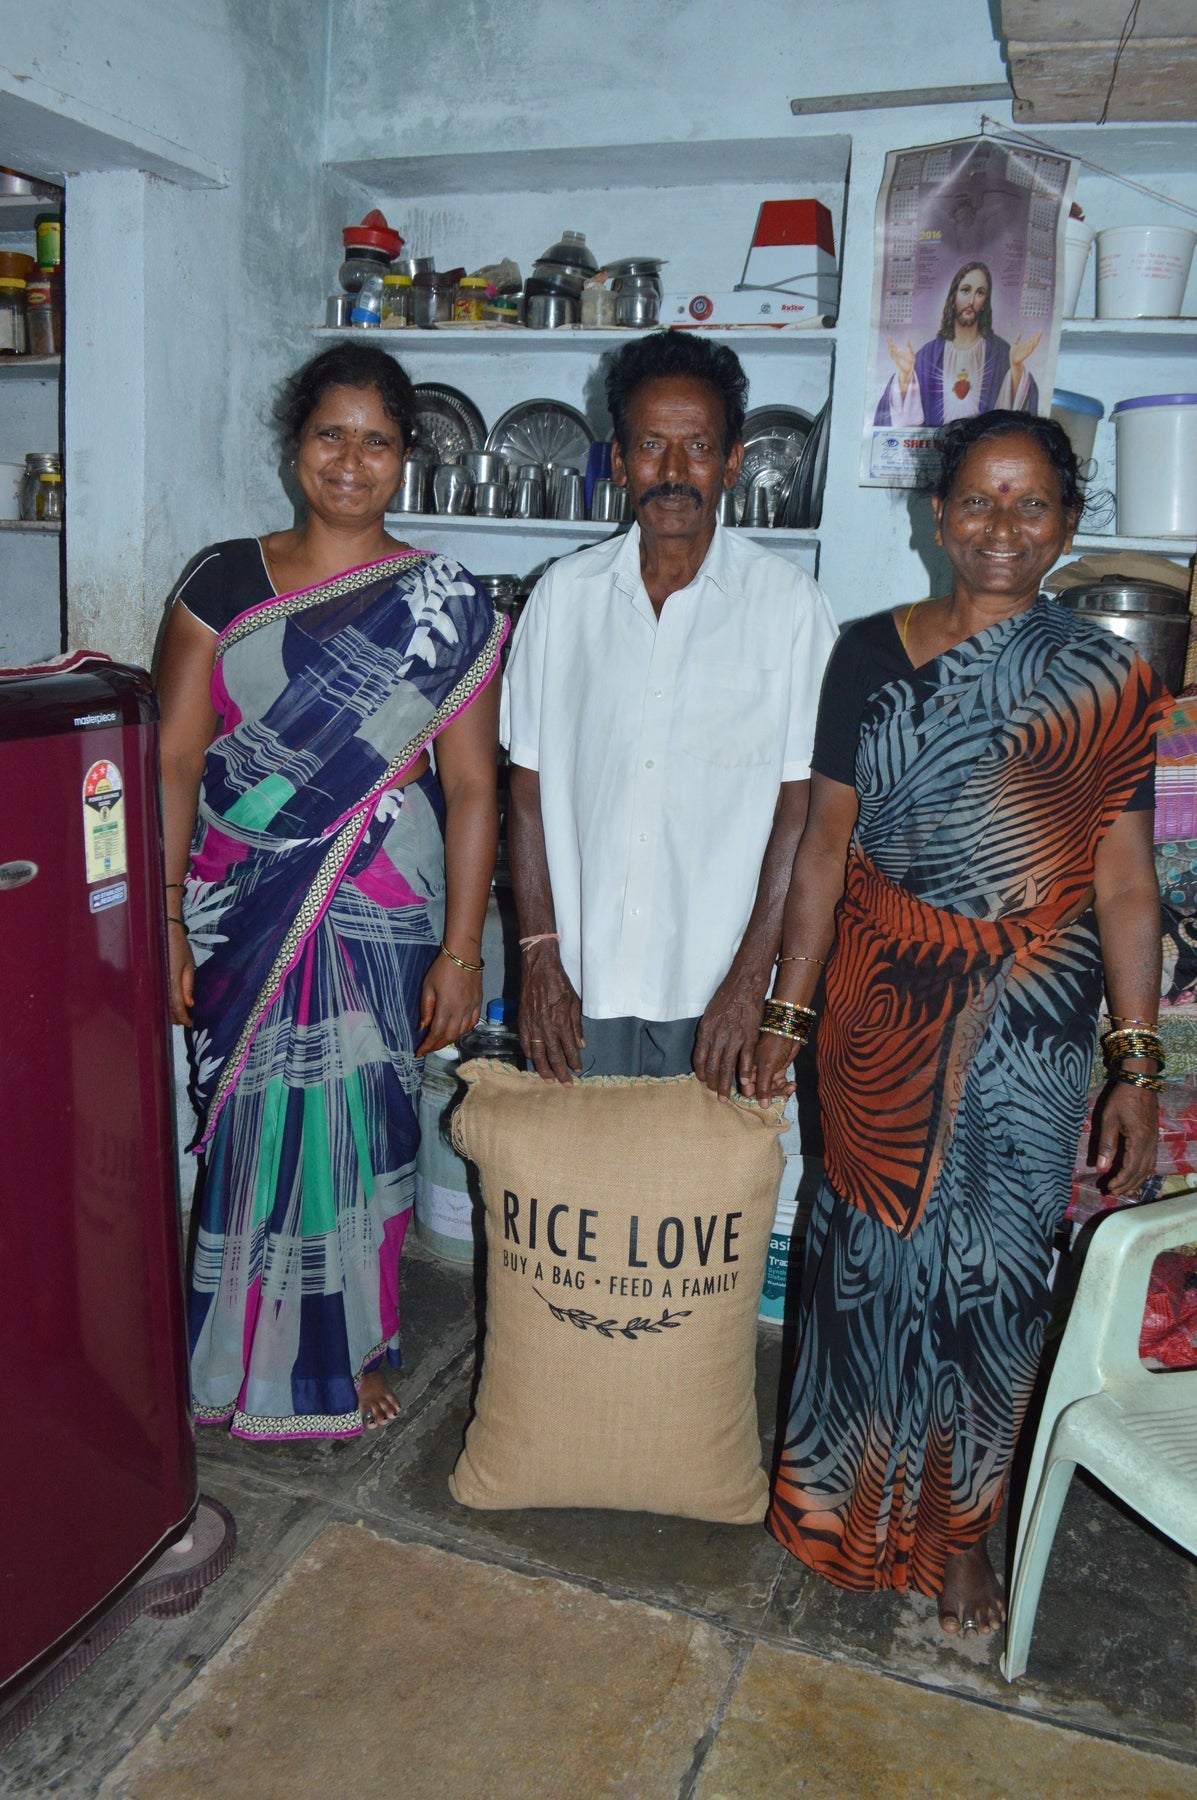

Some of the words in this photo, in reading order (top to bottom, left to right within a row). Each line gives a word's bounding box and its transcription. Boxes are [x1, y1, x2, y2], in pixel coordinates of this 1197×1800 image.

[920, 230, 942, 240] 2016
[903, 438, 931, 449] SREE
[74, 712, 117, 726] masterpiece
[503, 1189, 598, 1262] RICE
[628, 1212, 742, 1269] LOVE
[770, 1239, 790, 1251] asi
[769, 1256, 788, 1267] Trac
[503, 1249, 527, 1275] BUY
[534, 1262, 544, 1281] A
[552, 1266, 585, 1290] BAG
[609, 1276, 653, 1297] FEED
[662, 1279, 672, 1298] A
[682, 1271, 739, 1298] FAMILY
